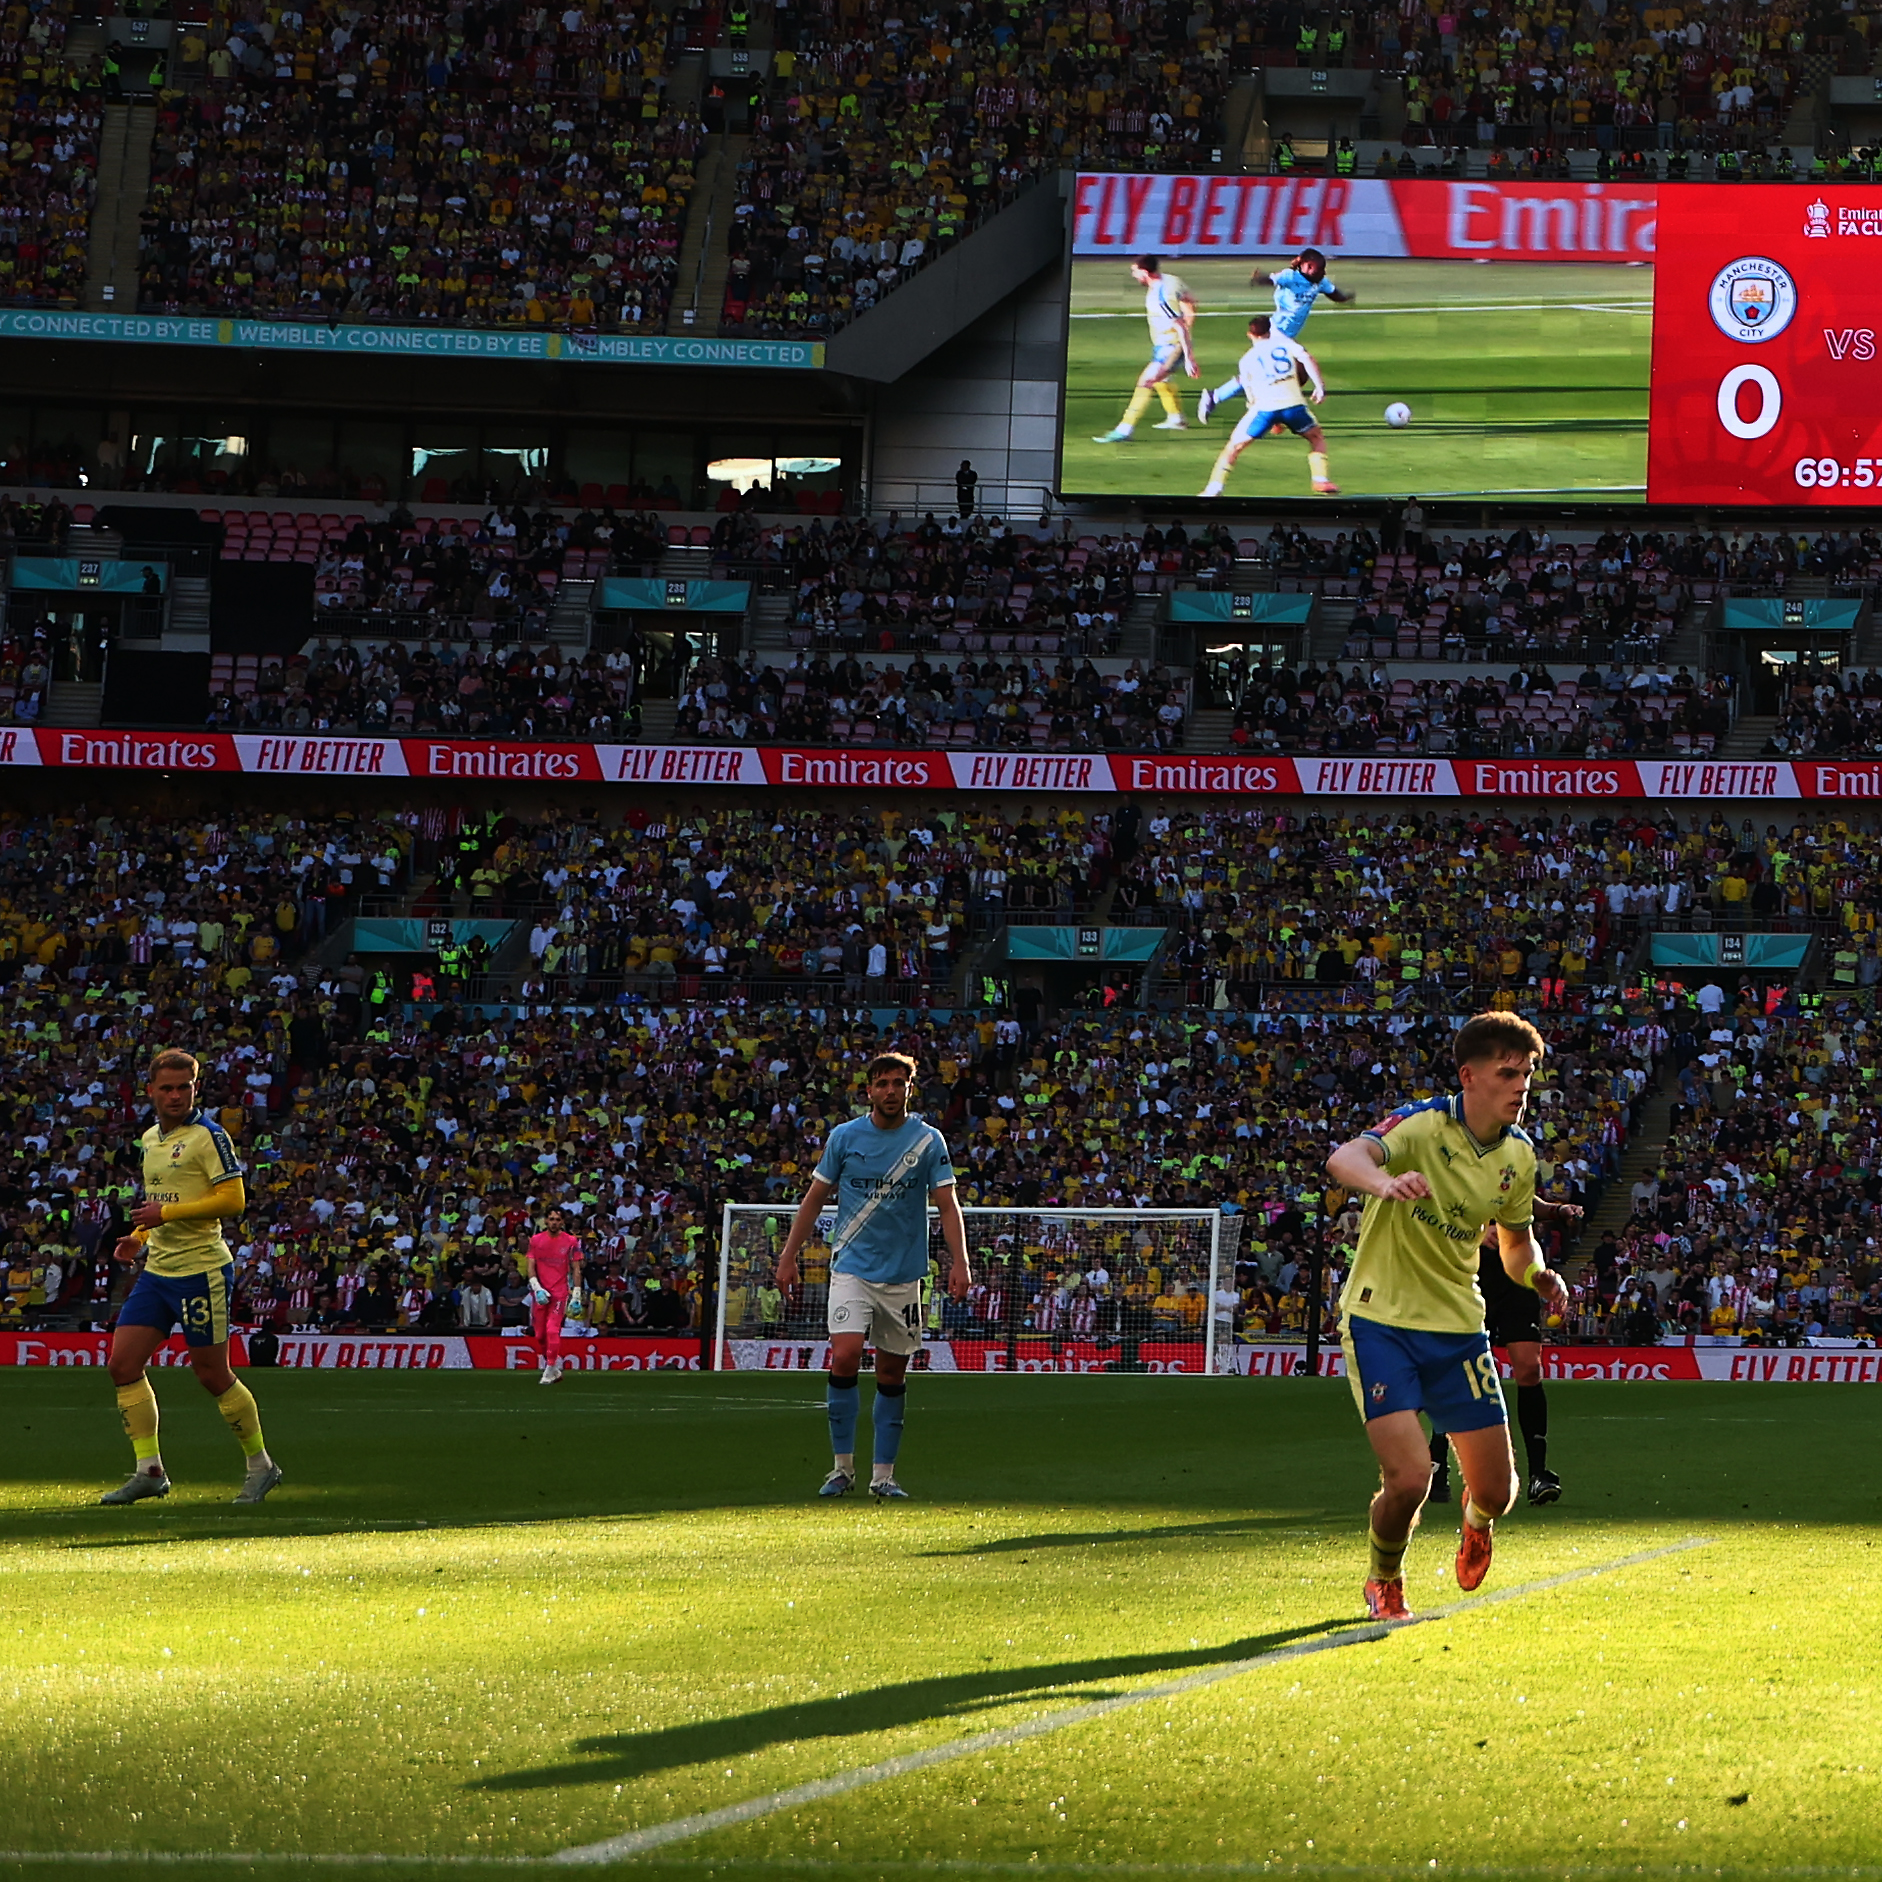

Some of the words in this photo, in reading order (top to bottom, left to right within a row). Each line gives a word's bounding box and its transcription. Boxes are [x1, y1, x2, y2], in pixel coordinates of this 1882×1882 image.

[1073, 175, 1152, 245] FLY
[1160, 176, 1352, 246] BETTER
[1838, 221, 1859, 236] FA
[1718, 262, 1788, 290] MANCHESTER
[13, 315, 150, 336] CONNECTED
[156, 322, 183, 337] BY
[189, 323, 211, 338] EE
[240, 326, 342, 344] WEMBLEY
[348, 331, 482, 350] CONNECTED
[487, 336, 513, 351] BY
[519, 338, 541, 352] EE
[674, 343, 804, 362] CONNECTED
[1739, 328, 1764, 338] CITY
[1824, 328, 1876, 360] VS
[1717, 364, 1782, 440] 0
[62, 734, 215, 767] Emirates
[257, 739, 297, 770] FLY
[299, 741, 385, 772] BETTER
[430, 745, 578, 777] Emirates
[618, 749, 658, 780] FLY
[661, 750, 743, 781] BETTER
[1133, 760, 1276, 790] Emirates
[1317, 762, 1354, 792] FLY
[1357, 762, 1437, 793] BETTER
[1476, 765, 1618, 793] Emirates
[1659, 765, 1696, 795] FLY
[1699, 765, 1778, 795] BETTER
[431, 923, 447, 934] 132
[1081, 931, 1097, 942] 133
[1724, 937, 1741, 948] 134
[850, 1177, 919, 1190] ETIHAD
[181, 1295, 211, 1327] 13
[902, 1302, 920, 1329] 14
[278, 1342, 329, 1367] FLY
[337, 1343, 446, 1368] BETTER
[1731, 1355, 1779, 1381] FLY
[1463, 1351, 1500, 1401] 18
